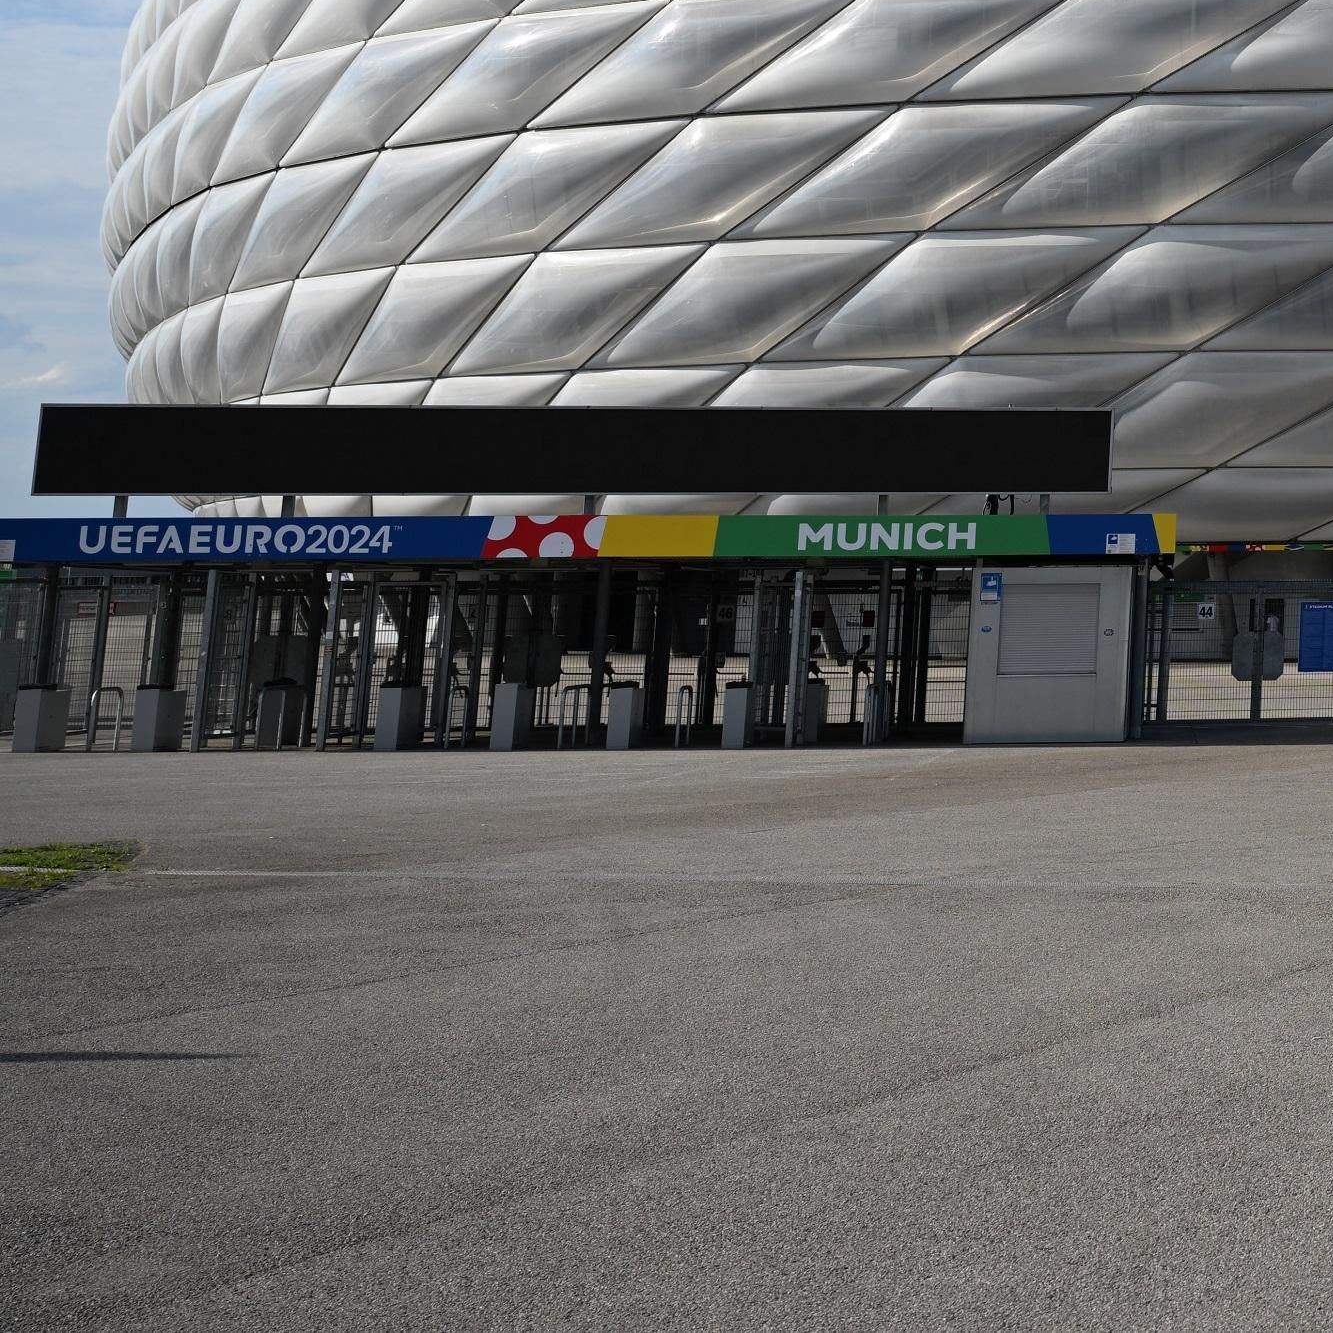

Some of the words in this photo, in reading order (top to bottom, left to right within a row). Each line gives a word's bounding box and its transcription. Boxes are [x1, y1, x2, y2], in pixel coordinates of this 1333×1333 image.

[796, 521, 978, 551] MUNICH
[718, 607, 733, 619] 46
[1199, 606, 1214, 618] 44
